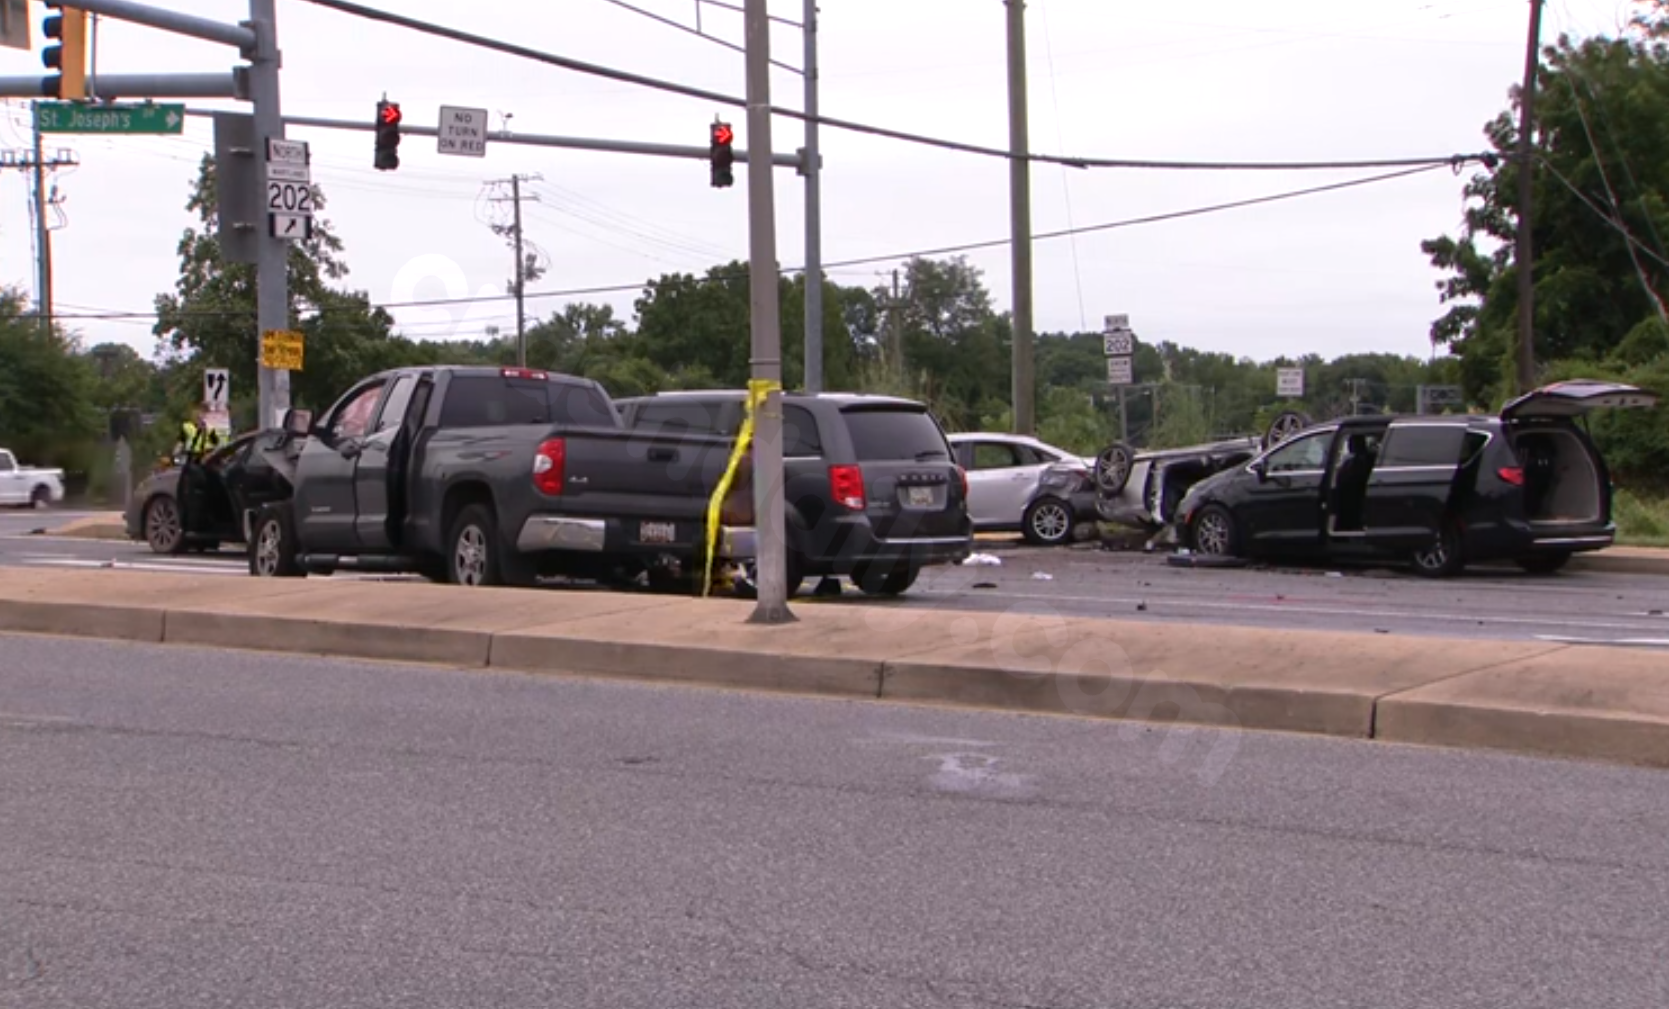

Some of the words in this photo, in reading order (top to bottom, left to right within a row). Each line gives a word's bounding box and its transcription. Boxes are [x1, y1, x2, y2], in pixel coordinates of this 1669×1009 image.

[68, 110, 131, 130] Joseph's
[454, 113, 472, 124] NO
[449, 125, 478, 137] TURN
[272, 144, 303, 160] NORTH
[440, 137, 456, 149] ON
[460, 139, 483, 152] RED
[268, 183, 311, 211] 202
[1106, 338, 1129, 352] 202
